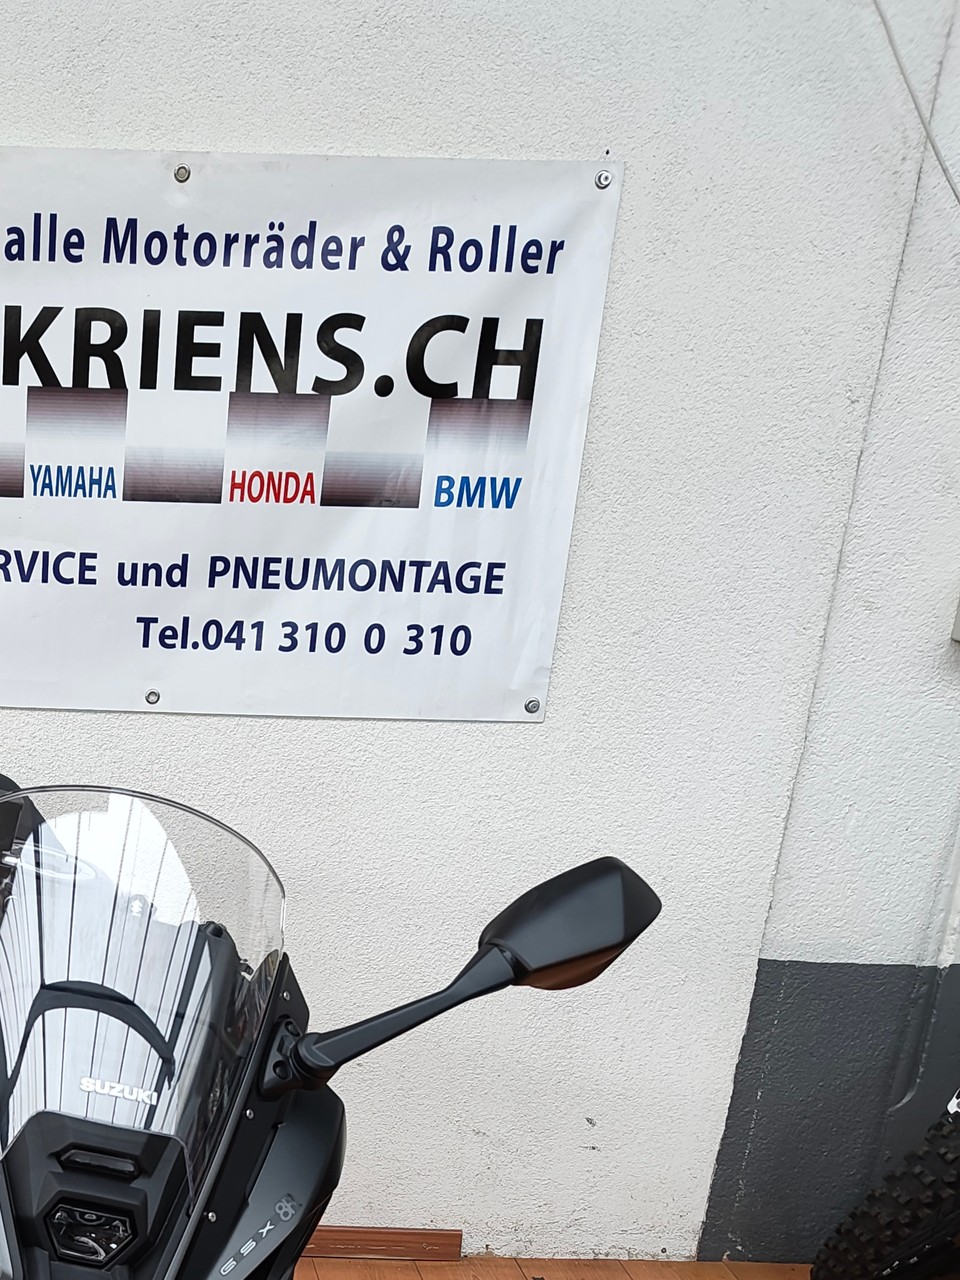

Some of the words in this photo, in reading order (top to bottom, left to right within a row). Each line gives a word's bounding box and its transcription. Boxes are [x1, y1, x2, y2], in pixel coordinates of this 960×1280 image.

[4, 212, 85, 264] alle
[102, 216, 366, 271] Motorräder
[380, 224, 412, 272] &
[428, 224, 566, 275] Roller
[28, 464, 118, 500] YAMAHA
[229, 470, 316, 505] HONDA
[434, 475, 523, 510] BMW
[117, 553, 190, 588] und
[207, 555, 507, 595] PNEUMONTAGE
[276, 620, 347, 654] 310
[363, 623, 386, 655] 0
[402, 623, 472, 657] 310
[79, 1076, 159, 1106] SUZUKI
